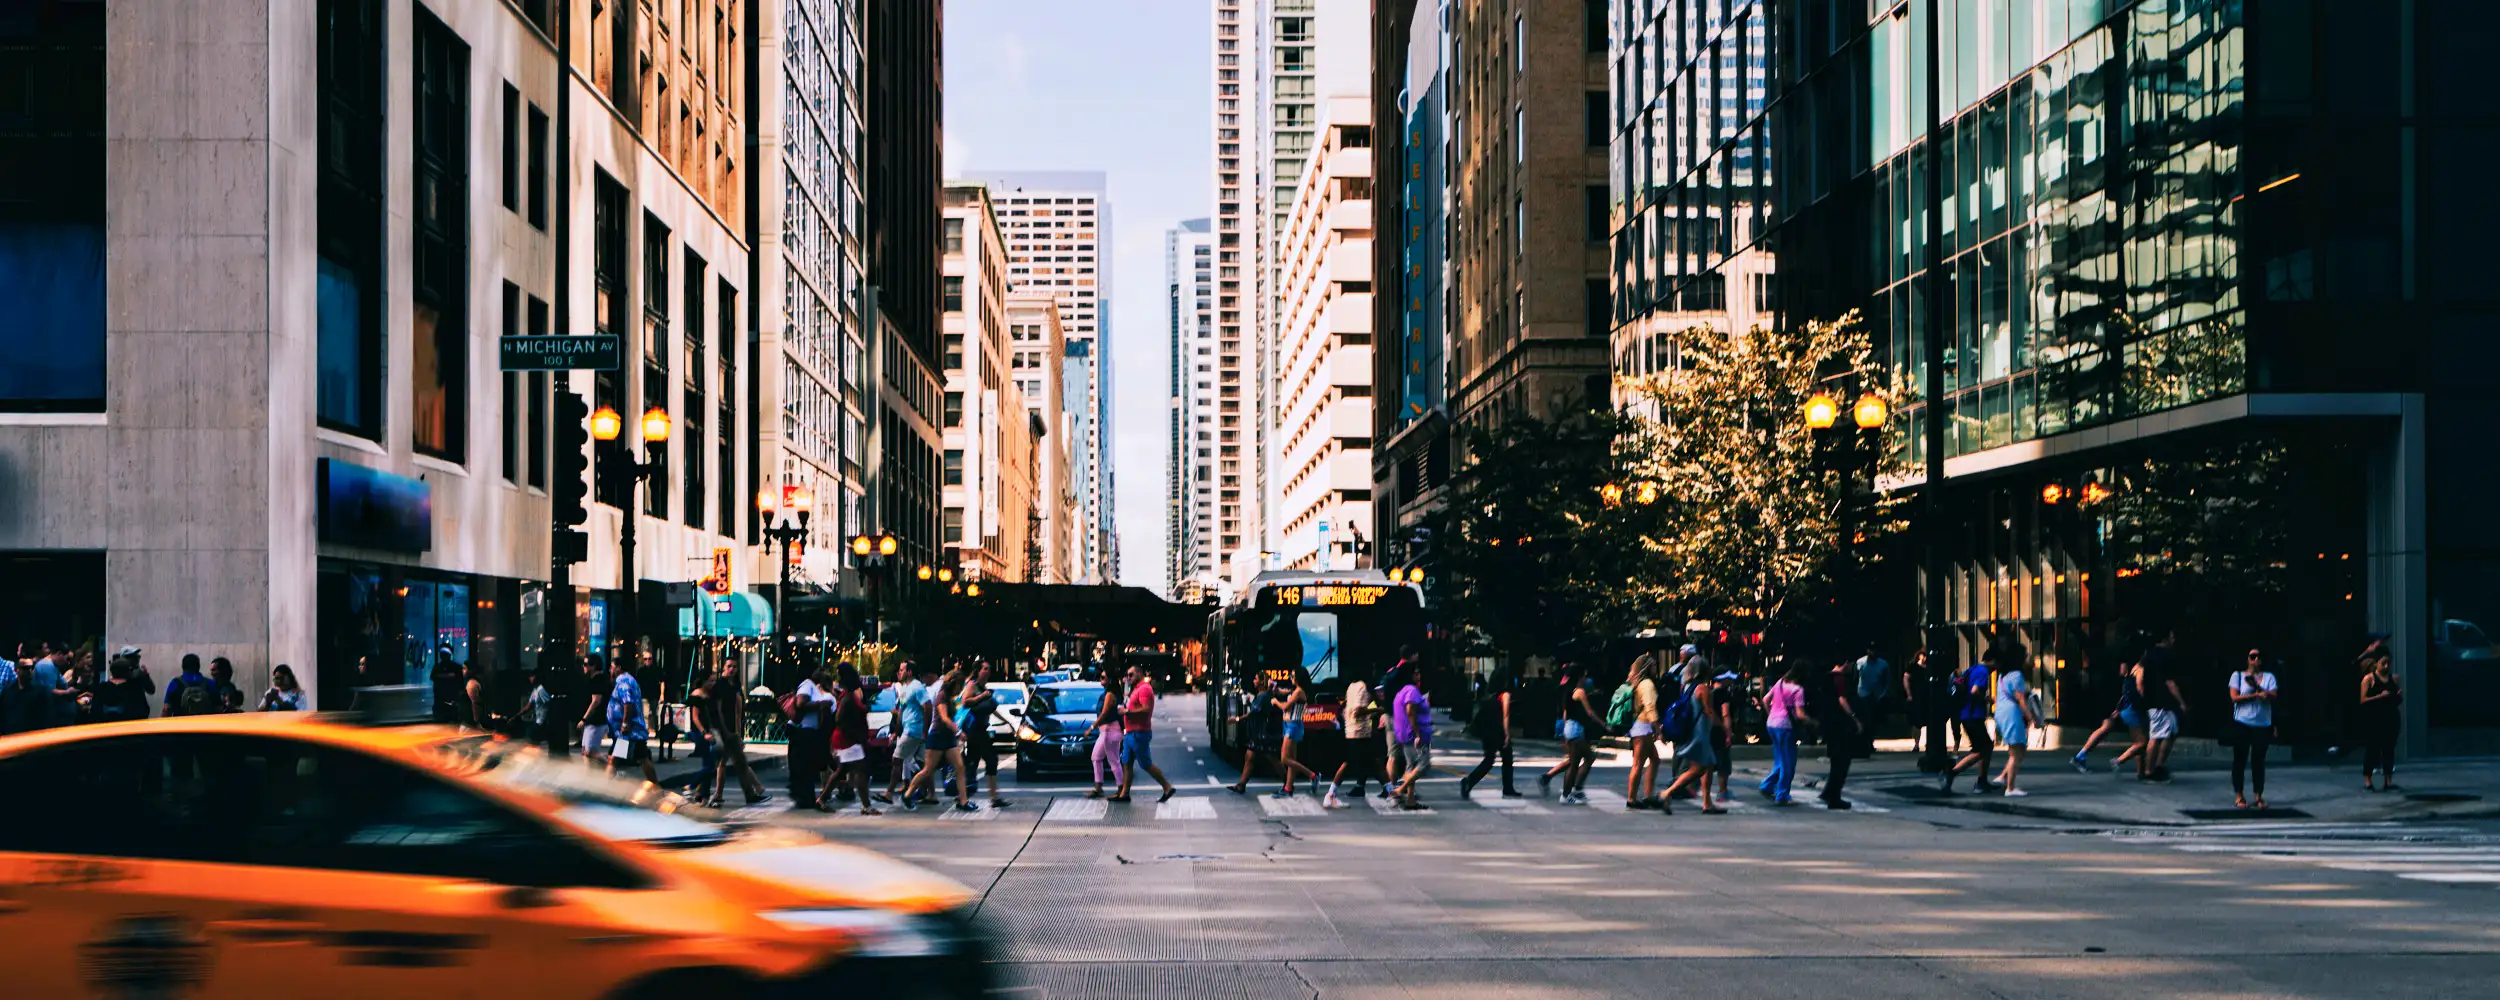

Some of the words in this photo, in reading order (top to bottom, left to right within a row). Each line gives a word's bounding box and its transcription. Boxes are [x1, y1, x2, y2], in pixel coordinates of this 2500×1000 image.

[1411, 265, 1421, 374] PARK
[504, 343, 511, 351] N
[516, 340, 595, 353] MICHIGAN
[600, 342, 614, 351] AV
[544, 356, 563, 365] 100
[568, 356, 575, 365] E
[715, 550, 728, 591] TACO
[1276, 586, 1300, 605] 146
